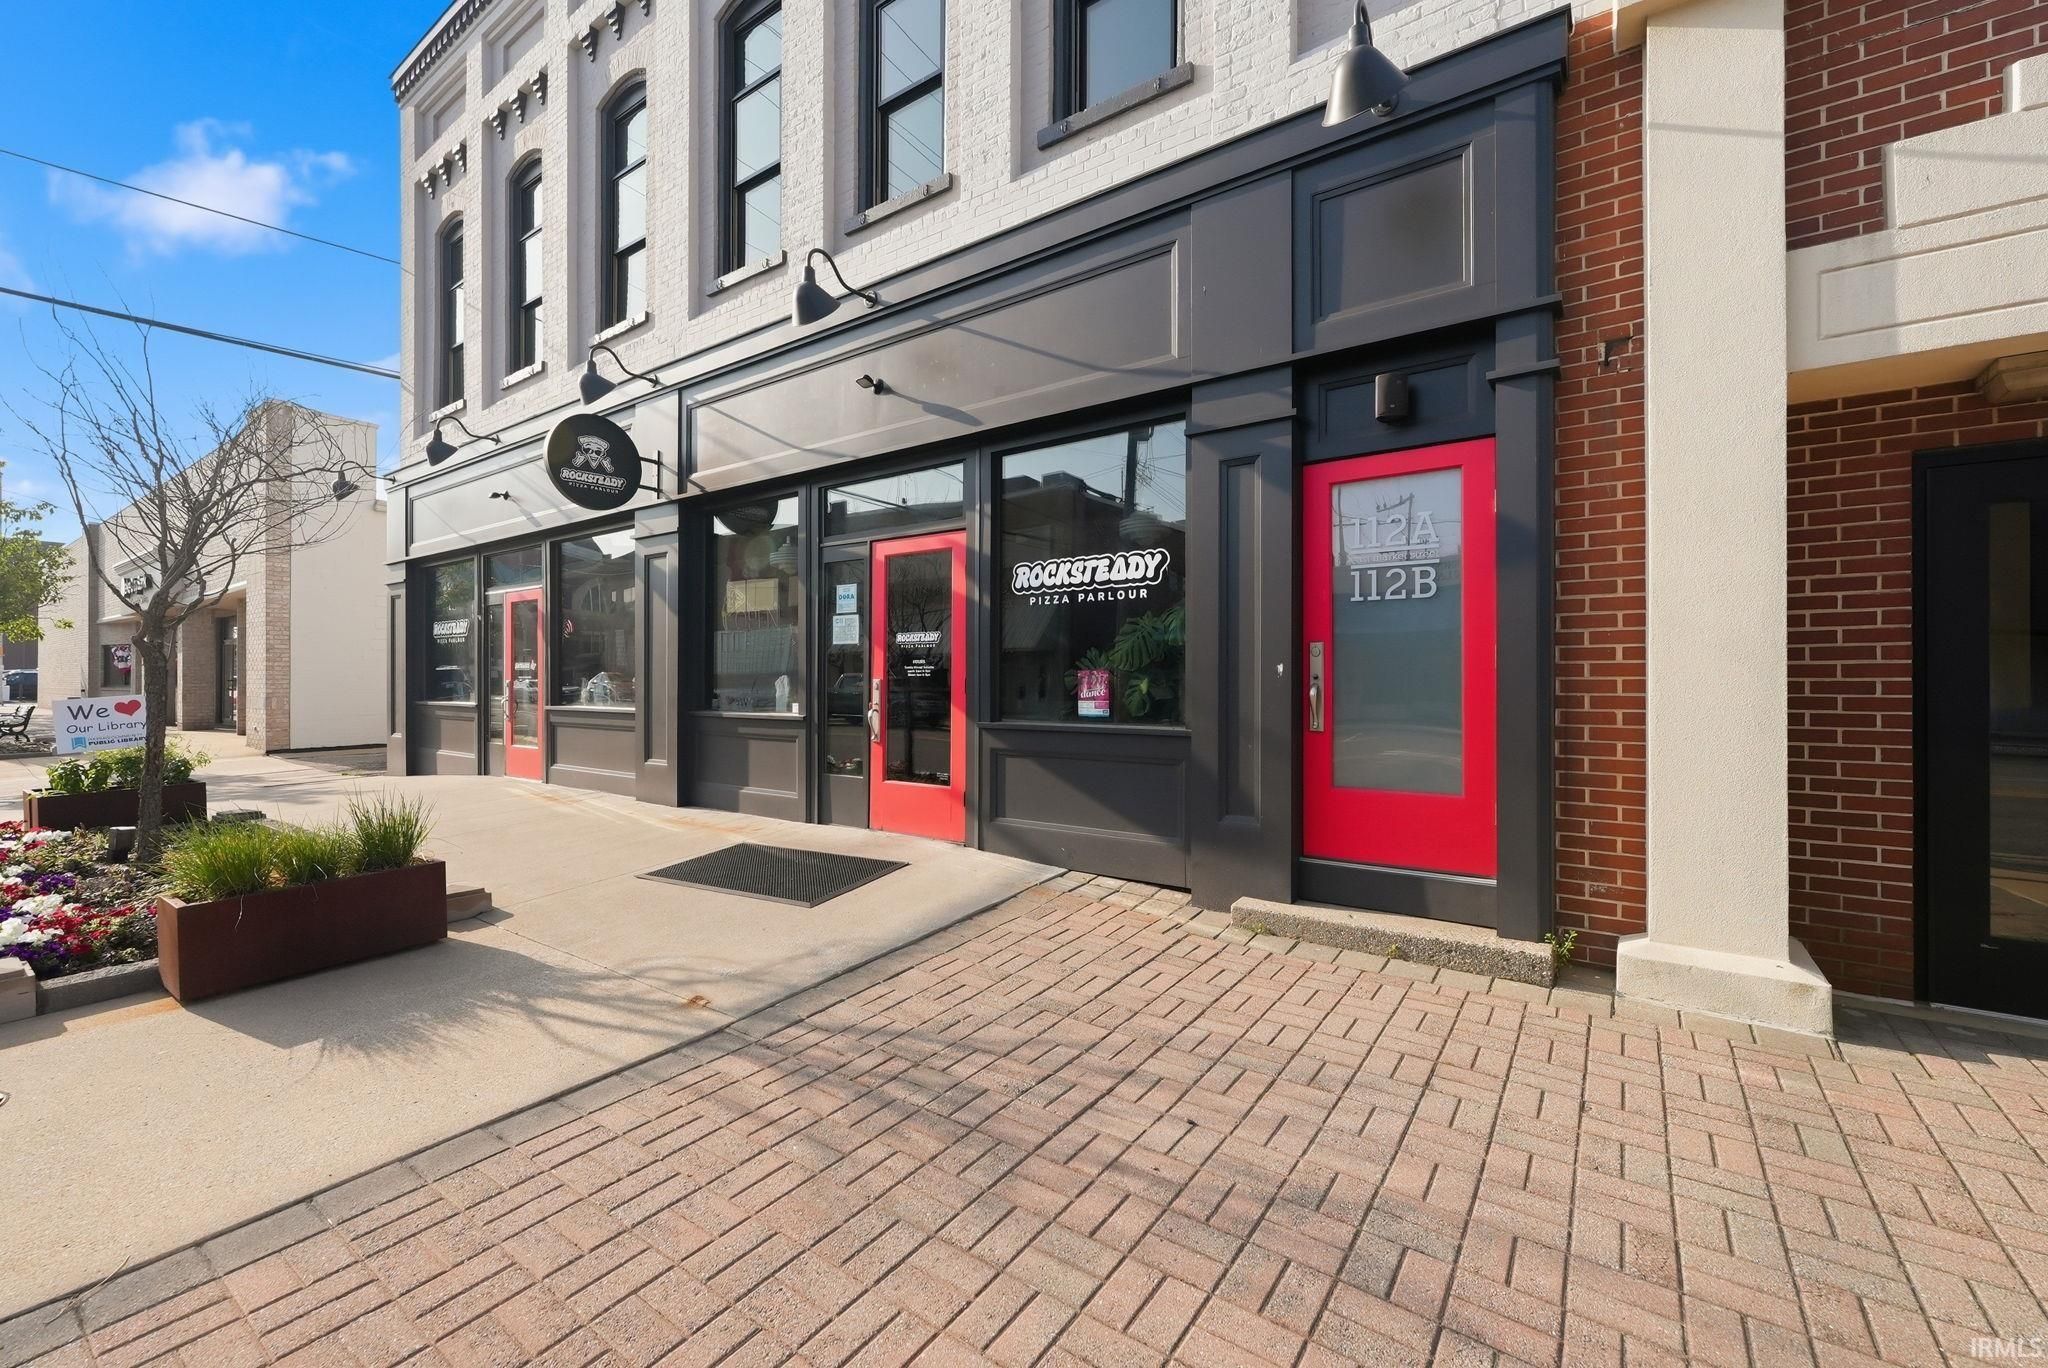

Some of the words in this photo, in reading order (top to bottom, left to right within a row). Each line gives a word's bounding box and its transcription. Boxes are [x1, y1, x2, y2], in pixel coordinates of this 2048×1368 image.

[560, 467, 626, 490] ROCKSTEADY
[1351, 511, 1440, 548] 112A
[1012, 548, 1170, 594] ROCKSTEADY
[1350, 566, 1437, 602] 112B
[1029, 595, 1070, 606] PIZZA
[1077, 588, 1148, 603] PARLOUR
[67, 704, 110, 721] We
[66, 725, 94, 734] Our
[98, 721, 146, 732] Library
